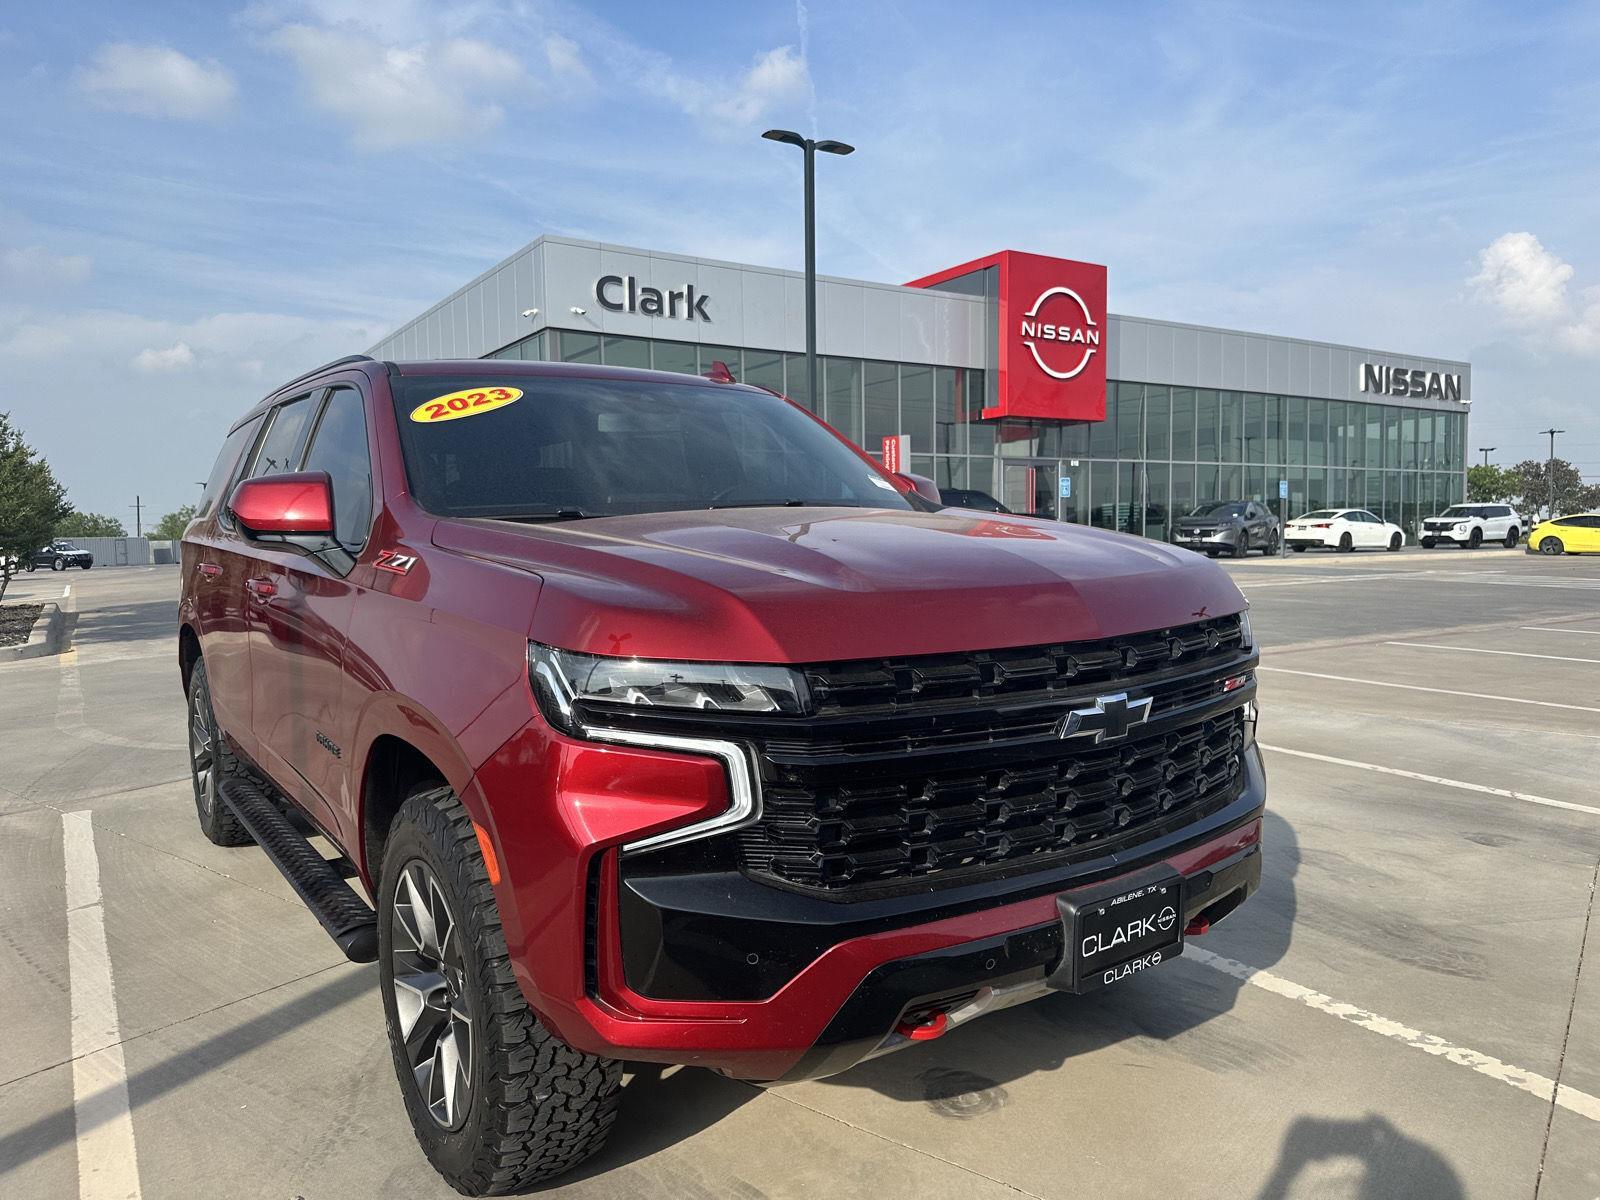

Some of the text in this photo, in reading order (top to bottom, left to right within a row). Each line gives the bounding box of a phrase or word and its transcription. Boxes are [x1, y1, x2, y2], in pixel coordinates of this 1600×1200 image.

[595, 275, 712, 322] Clark
[1021, 321, 1100, 345] NISSAN
[1360, 363, 1462, 401] NISSAN
[425, 388, 514, 420] 2023
[373, 550, 418, 576] Z71
[1147, 885, 1157, 894] TX
[1082, 913, 1156, 958] CLARK
[1103, 955, 1152, 985] CLARK
